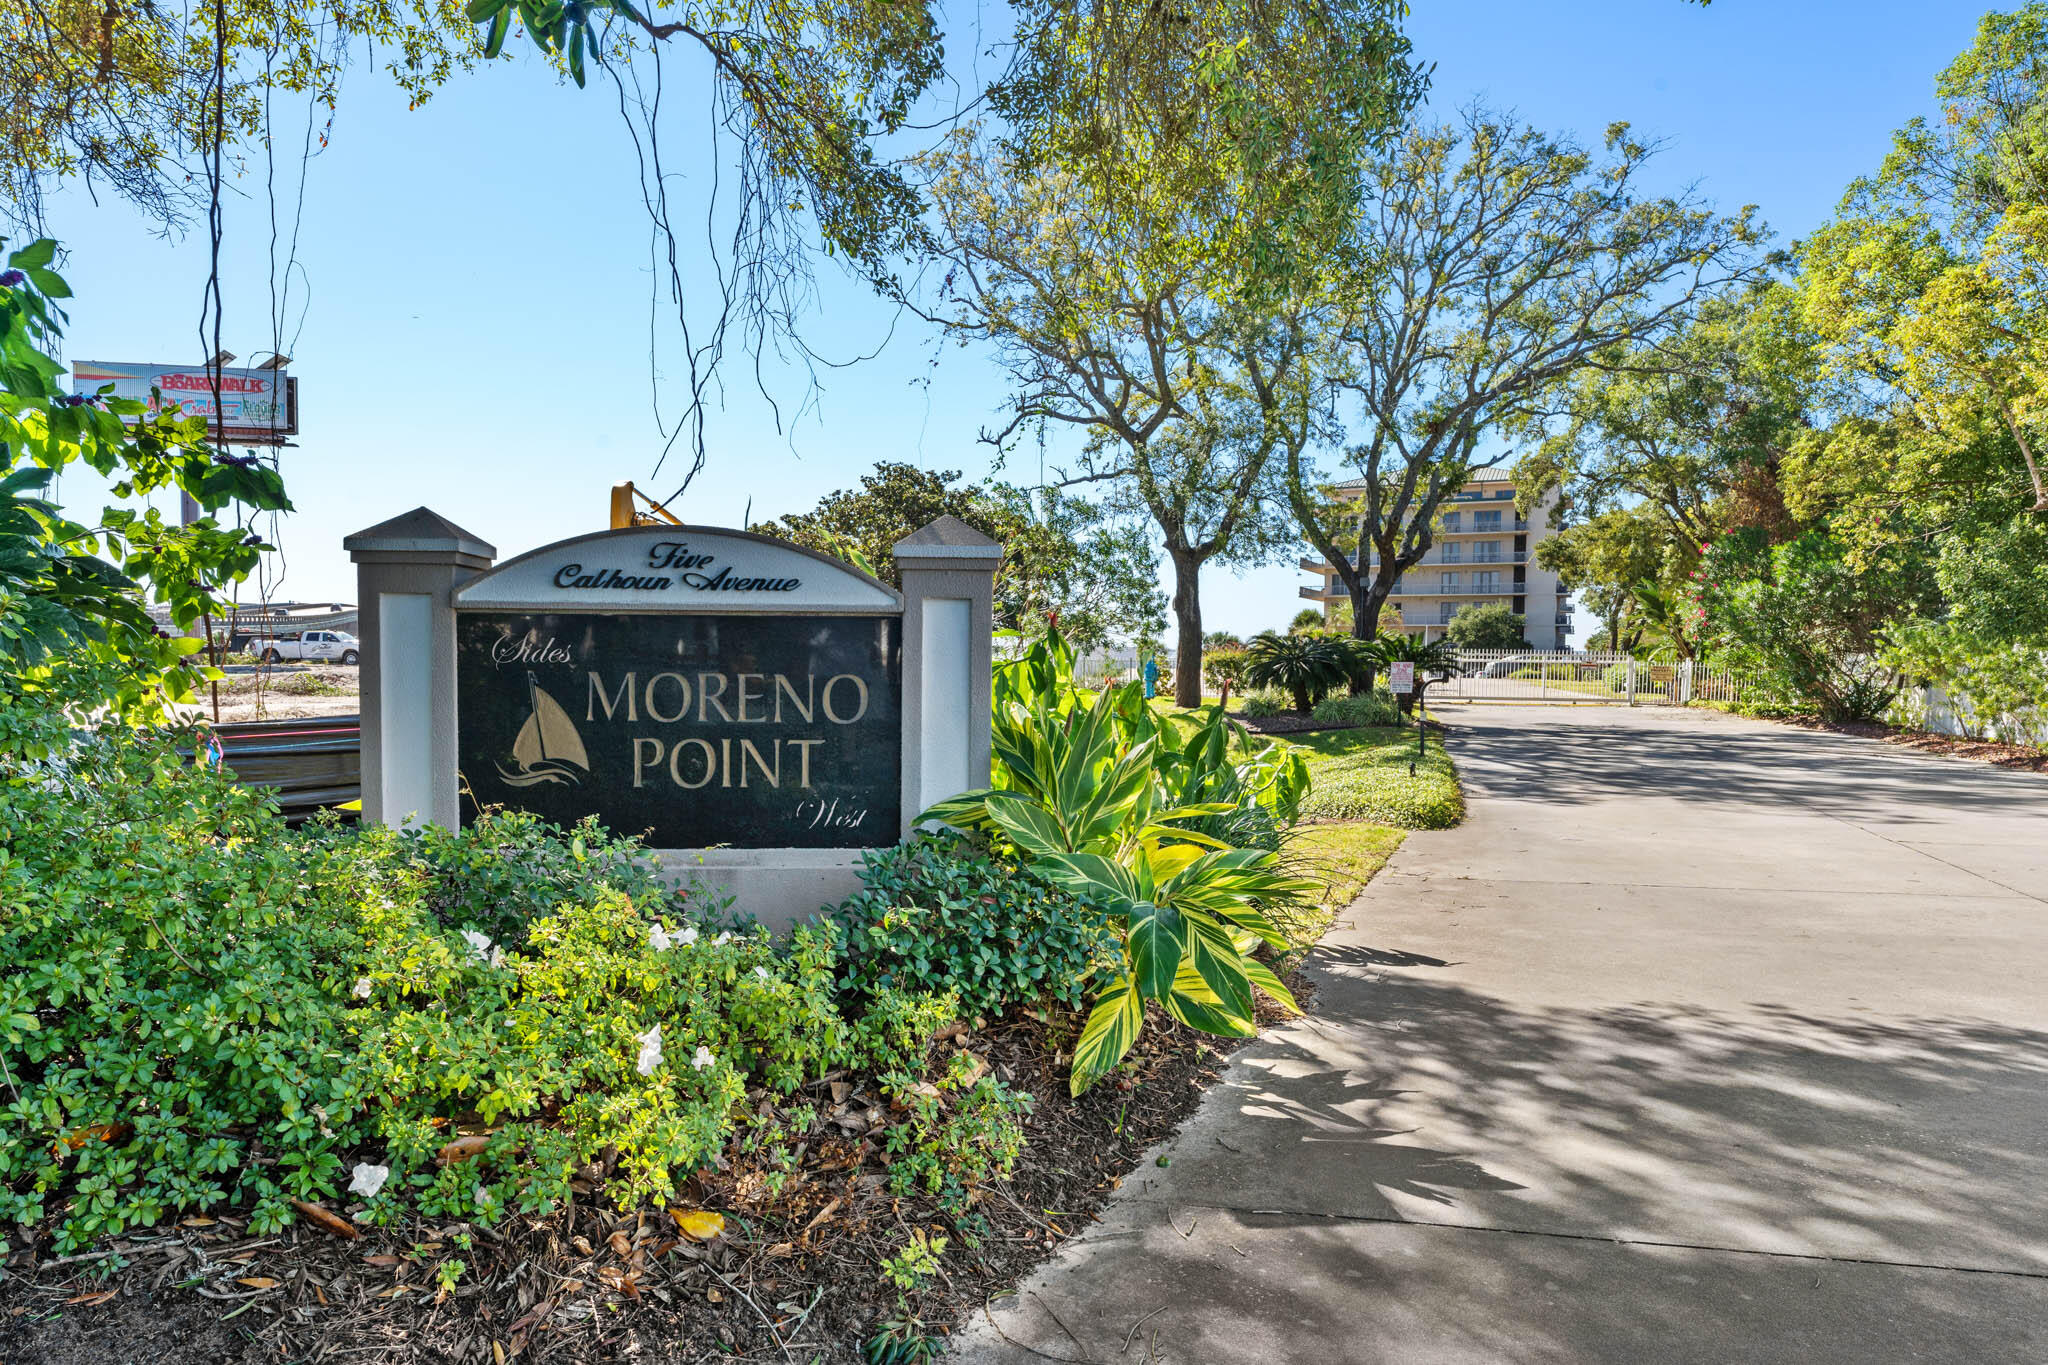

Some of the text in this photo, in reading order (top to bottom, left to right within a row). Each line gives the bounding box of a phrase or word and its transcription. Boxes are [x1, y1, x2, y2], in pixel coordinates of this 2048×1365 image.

[649, 541, 715, 569] Five
[553, 563, 803, 592] Calhoun Avenue
[491, 631, 577, 671] Sides
[585, 670, 869, 725] MORENO
[632, 737, 826, 790] POINT
